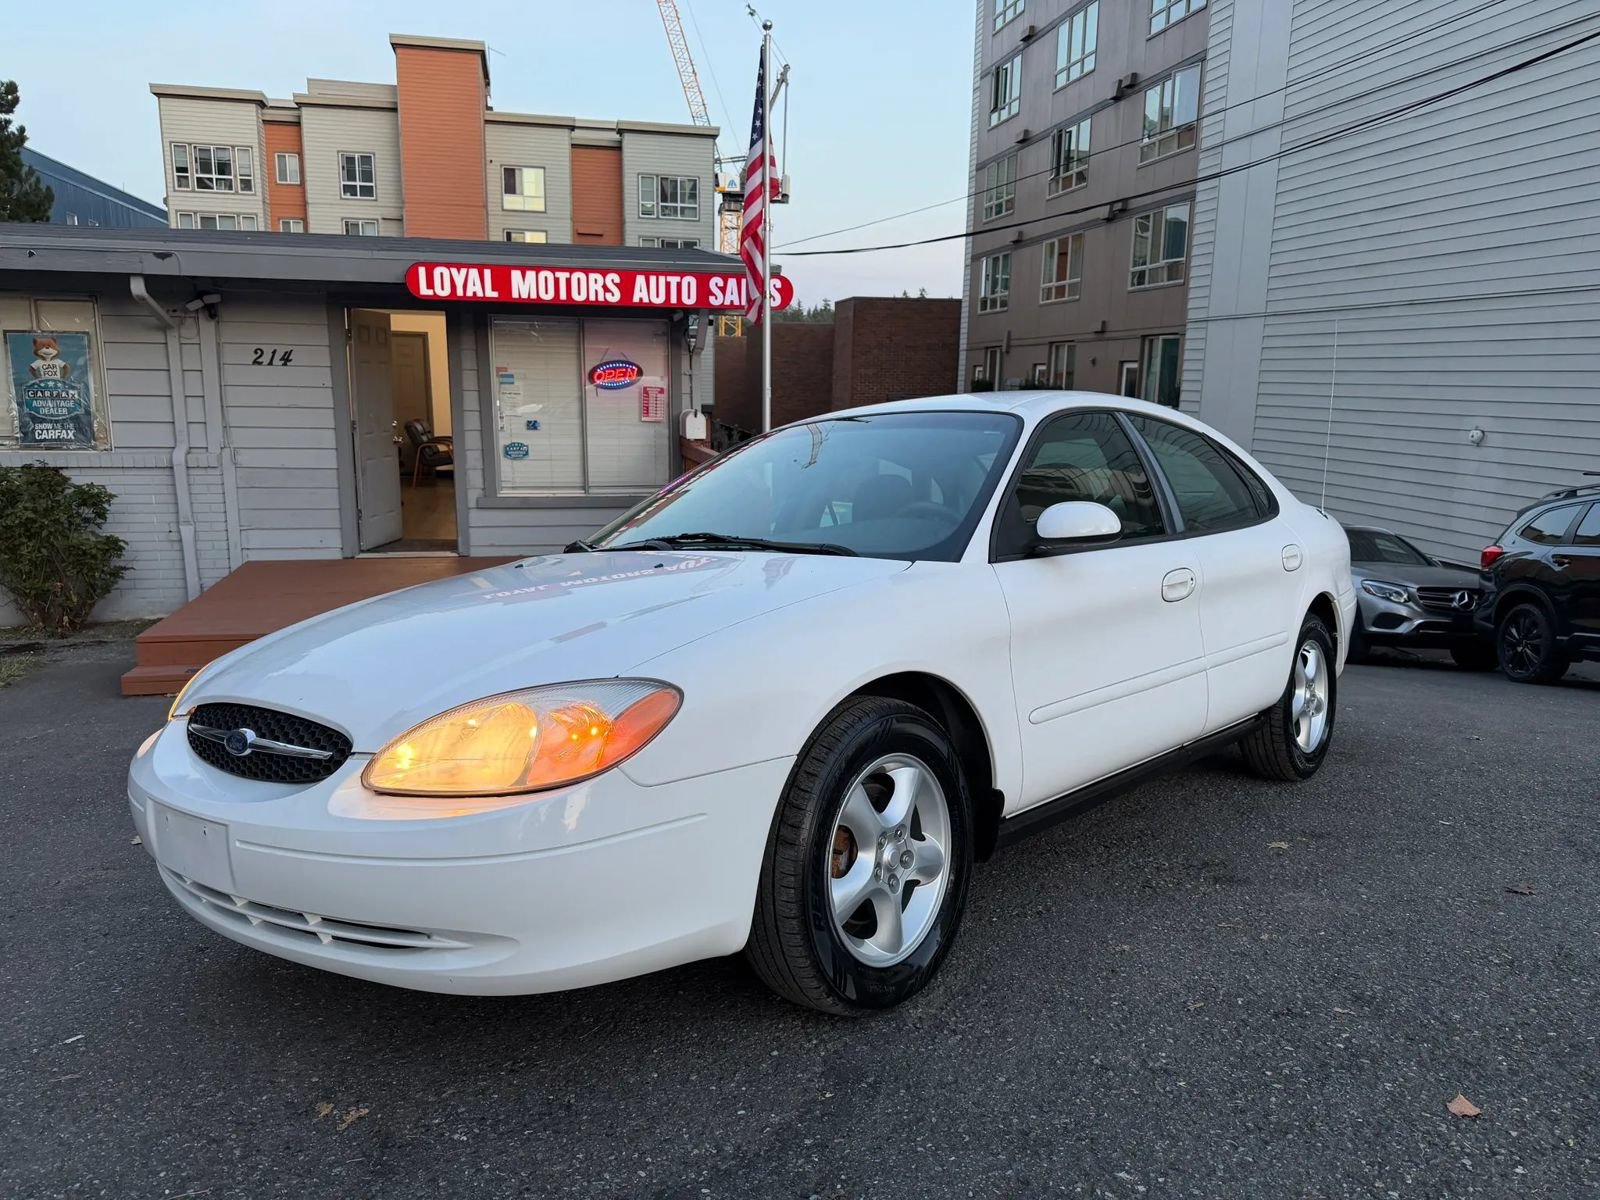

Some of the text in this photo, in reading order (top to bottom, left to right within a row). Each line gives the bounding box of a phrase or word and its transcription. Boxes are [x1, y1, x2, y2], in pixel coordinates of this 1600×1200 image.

[418, 266, 782, 307] LOYAL MOTORS AUTO SAS
[252, 348, 294, 366] 214
[594, 368, 638, 382] OPEN
[28, 390, 78, 398] CARFAX
[40, 407, 68, 415] DEALER
[35, 430, 76, 440] CARFAX
